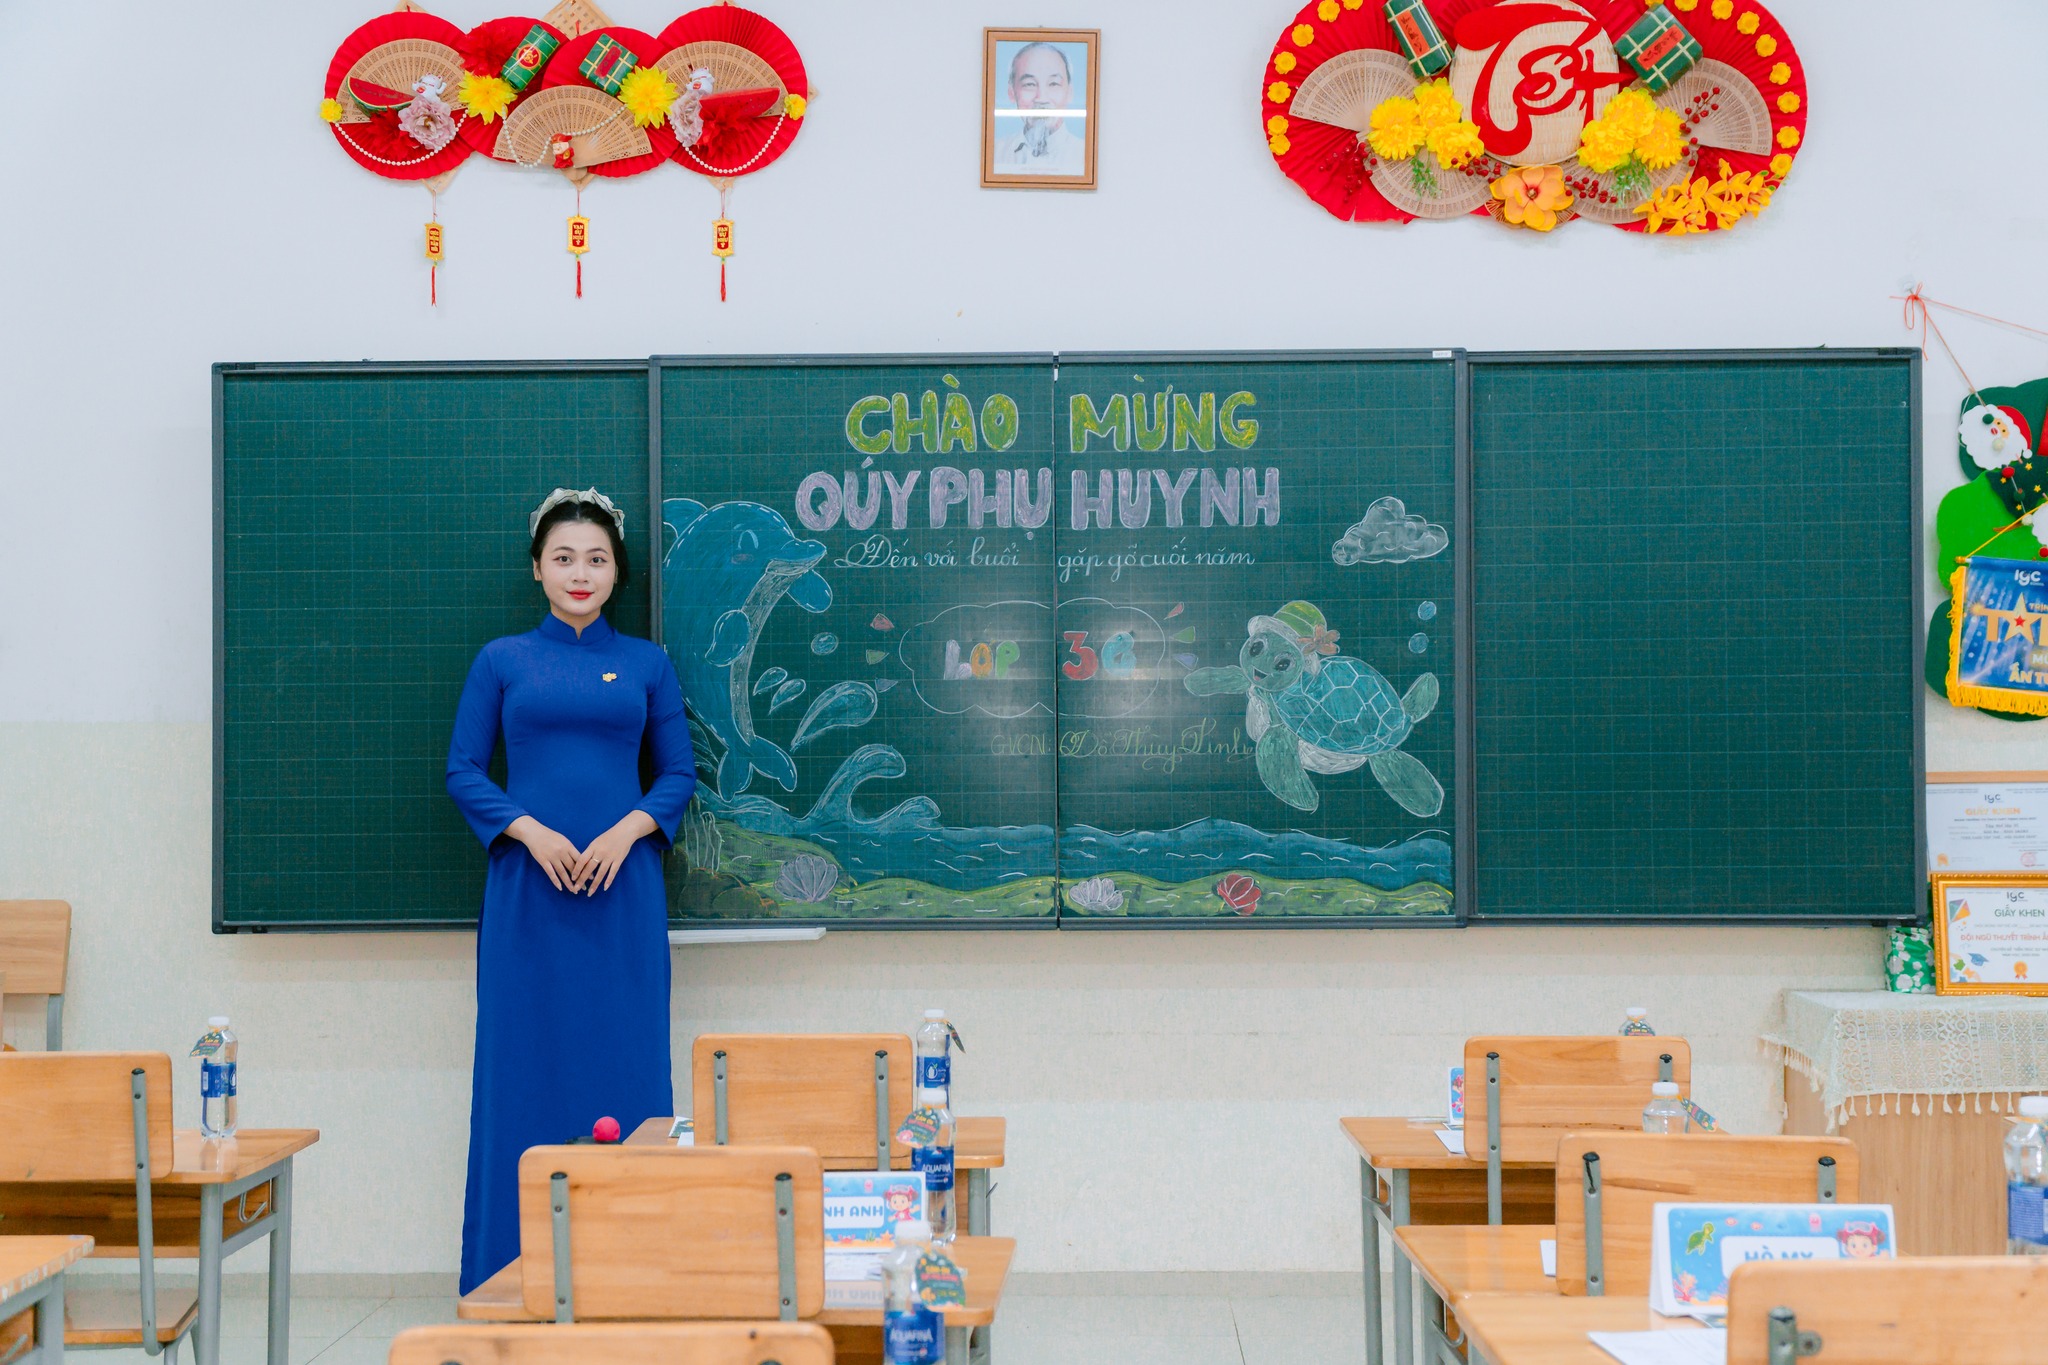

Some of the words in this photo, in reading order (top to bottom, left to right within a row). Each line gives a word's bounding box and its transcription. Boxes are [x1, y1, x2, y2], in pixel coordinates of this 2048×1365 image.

[845, 373, 1019, 454] CHÀO
[1069, 374, 1260, 453] MỪNG
[929, 466, 1052, 540] PHỤ
[1071, 466, 1280, 531] HUYNH
[834, 534, 918, 568] Đến
[924, 540, 958, 566] với
[967, 536, 1019, 566] buổi
[1058, 547, 1103, 583] gặp
[1140, 537, 1190, 568] cuối
[1195, 547, 1256, 566] năm
[1994, 904, 2016, 917] GIẤY
[2019, 909, 2045, 917] KHEN
[849, 1205, 884, 1217] ANH
